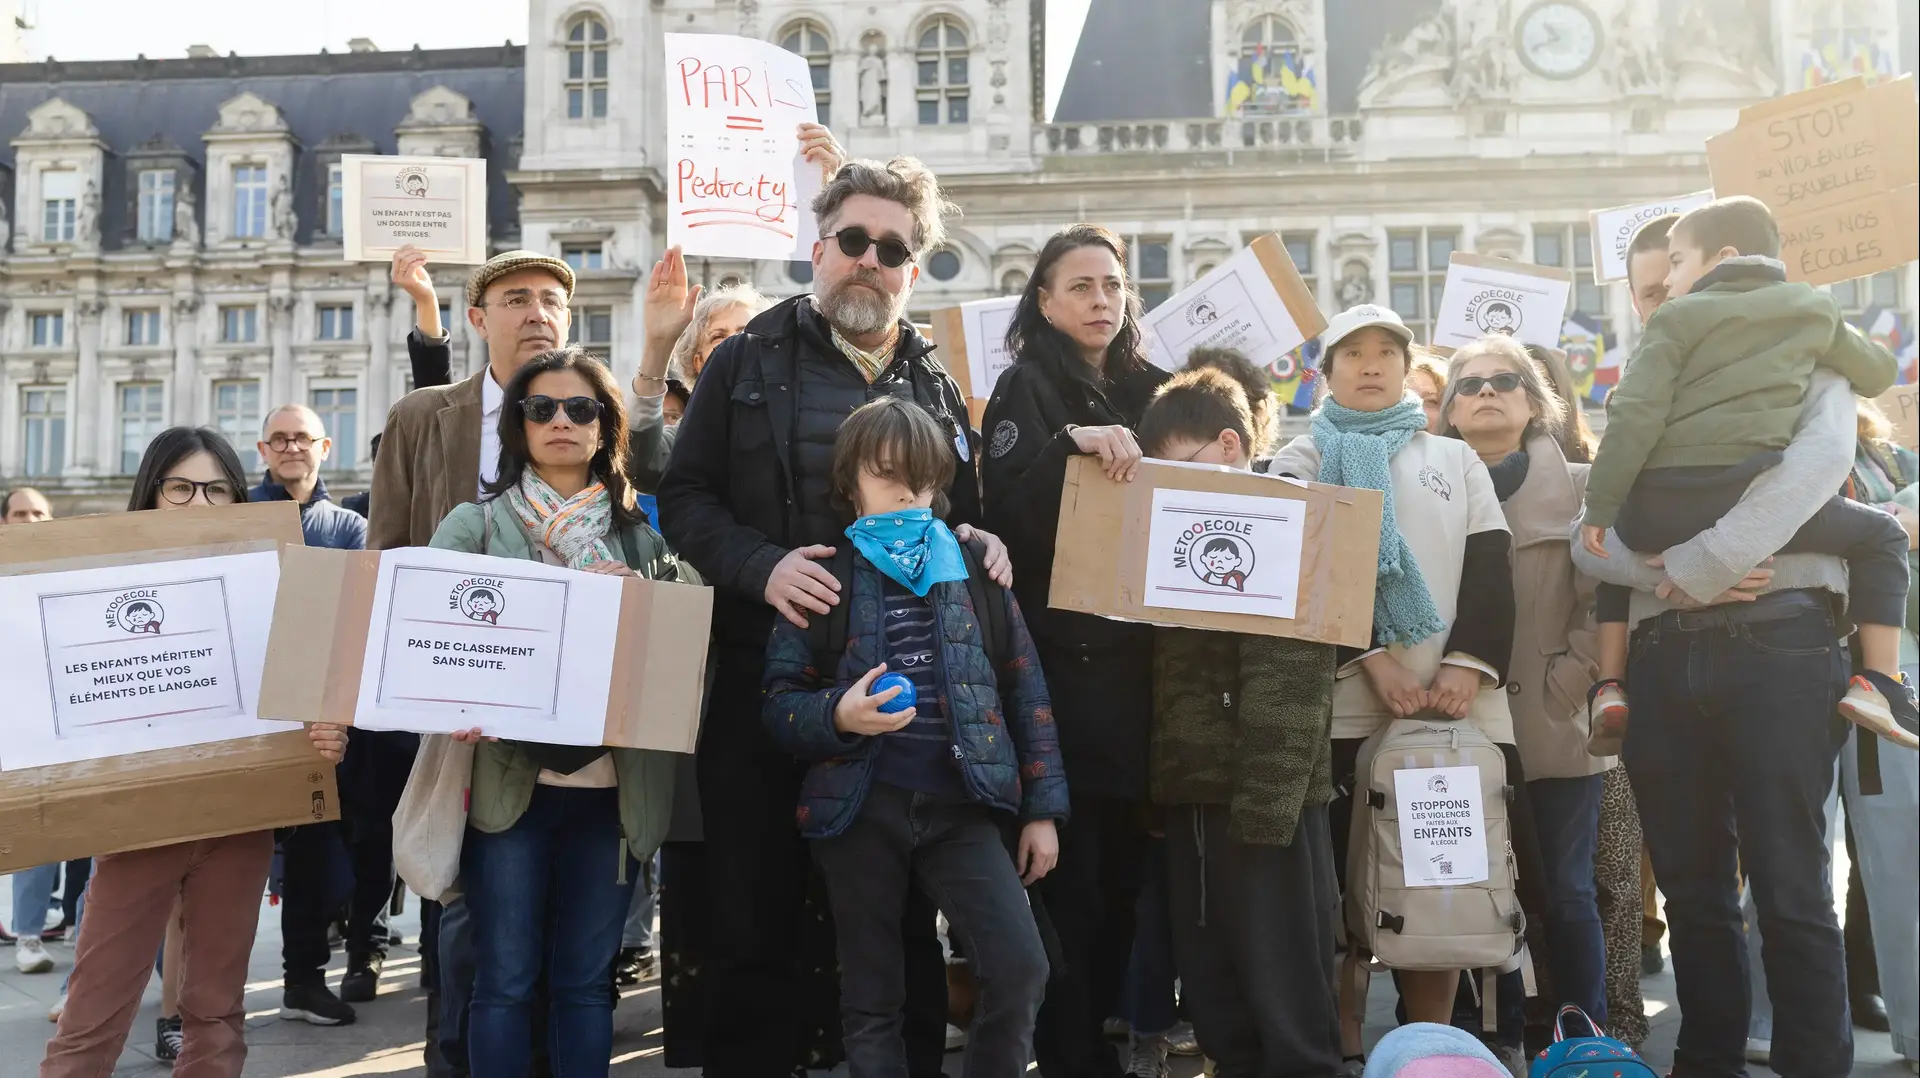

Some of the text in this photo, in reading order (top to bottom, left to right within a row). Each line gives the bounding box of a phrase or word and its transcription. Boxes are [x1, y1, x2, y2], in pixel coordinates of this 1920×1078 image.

[1768, 101, 1854, 152] STOP
[1778, 140, 1876, 177] VIOLENCES
[678, 158, 797, 222] Pedocity
[1775, 164, 1877, 207] SEXUELLES
[1779, 211, 1879, 248] DANS NOS
[1801, 240, 1882, 274] ÉCOLES
[1465, 290, 1524, 322] METOOECOLE
[1224, 319, 1240, 331] PLUS
[1240, 322, 1251, 331] ON
[1173, 519, 1253, 568] METOOECOLE
[106, 590, 158, 628] METOOECOLE
[449, 578, 504, 610] METOOECOLE
[66, 648, 213, 674] LES ENFANTS MÉRITENT
[408, 639, 535, 656] PAS DE CLASSEMENT
[433, 656, 506, 670] SANS SUITE.
[70, 677, 218, 704] ÉLÉMENTS DE LANGAGE
[94, 666, 191, 685] MIEUX QUE VOS
[1411, 800, 1469, 810] STOPPONS
[1414, 827, 1472, 839] ENFANTS
